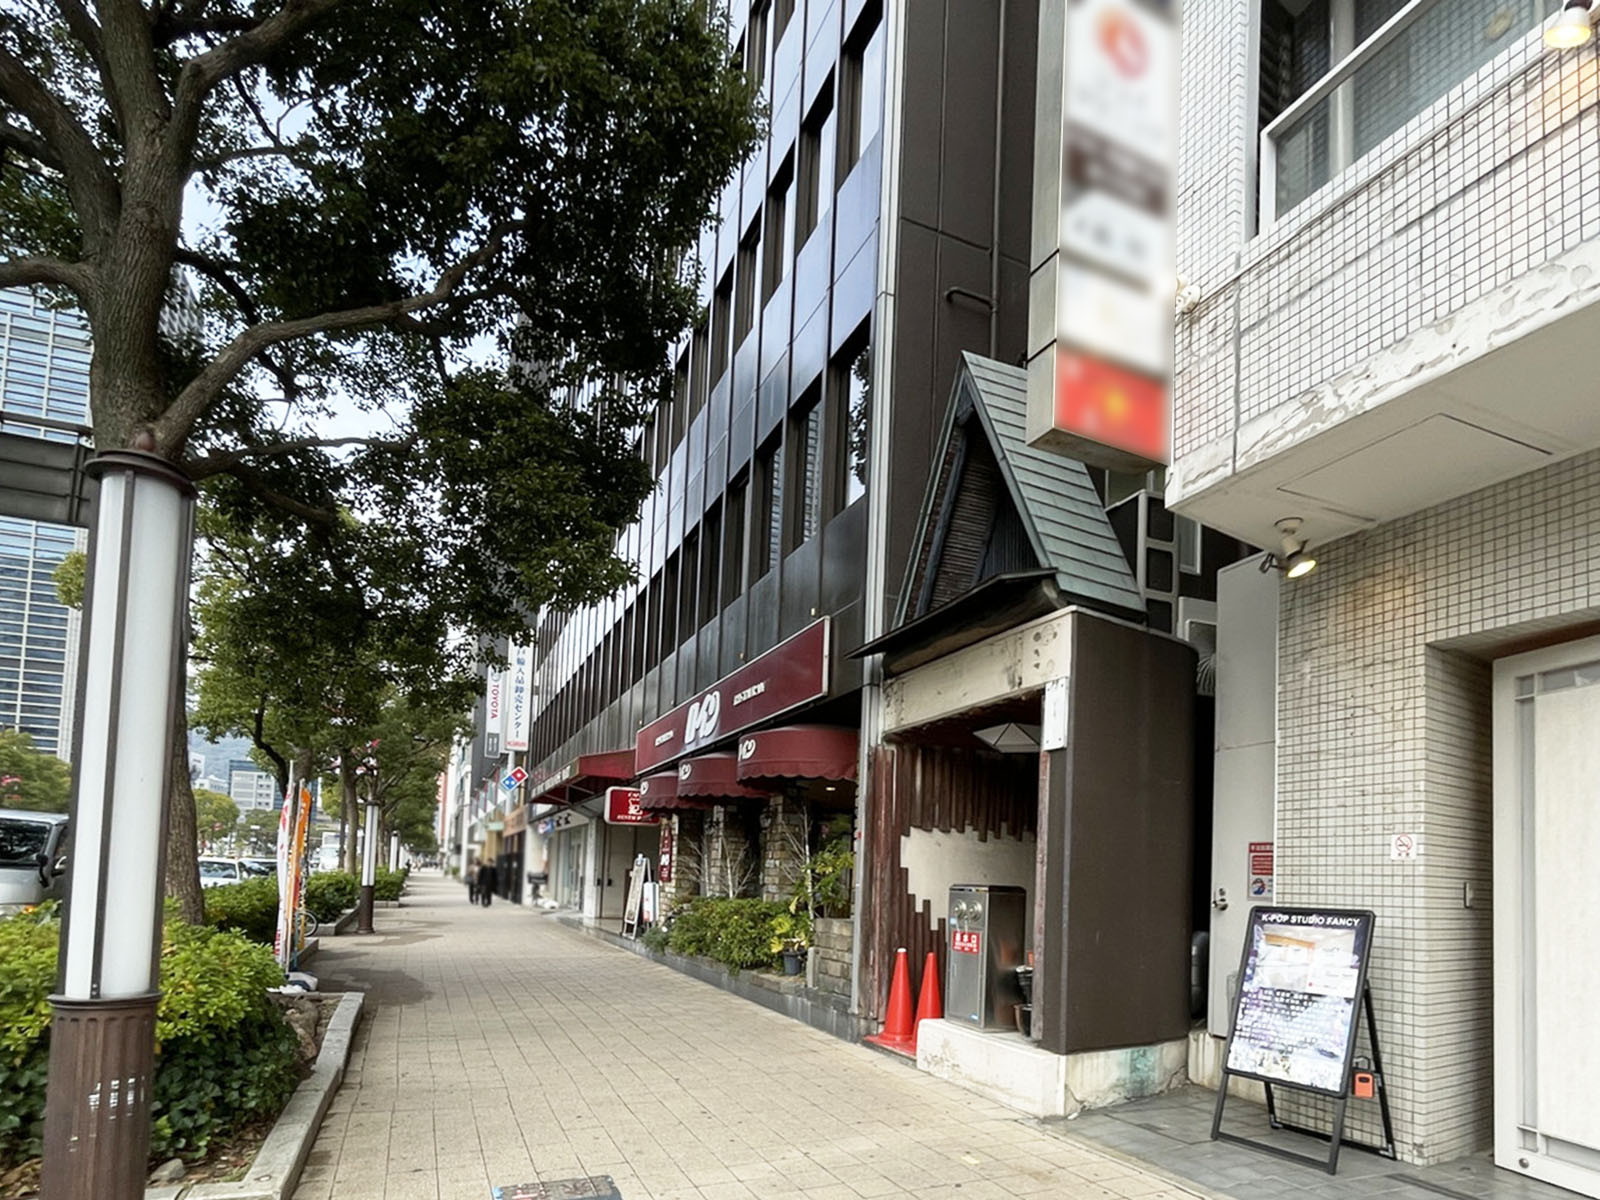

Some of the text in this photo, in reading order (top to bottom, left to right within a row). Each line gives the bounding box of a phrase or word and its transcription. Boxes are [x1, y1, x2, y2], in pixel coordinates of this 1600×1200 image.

[491, 684, 499, 719] TOYOTA
[1261, 914, 1360, 927] K-POP STUDIO FANCY
